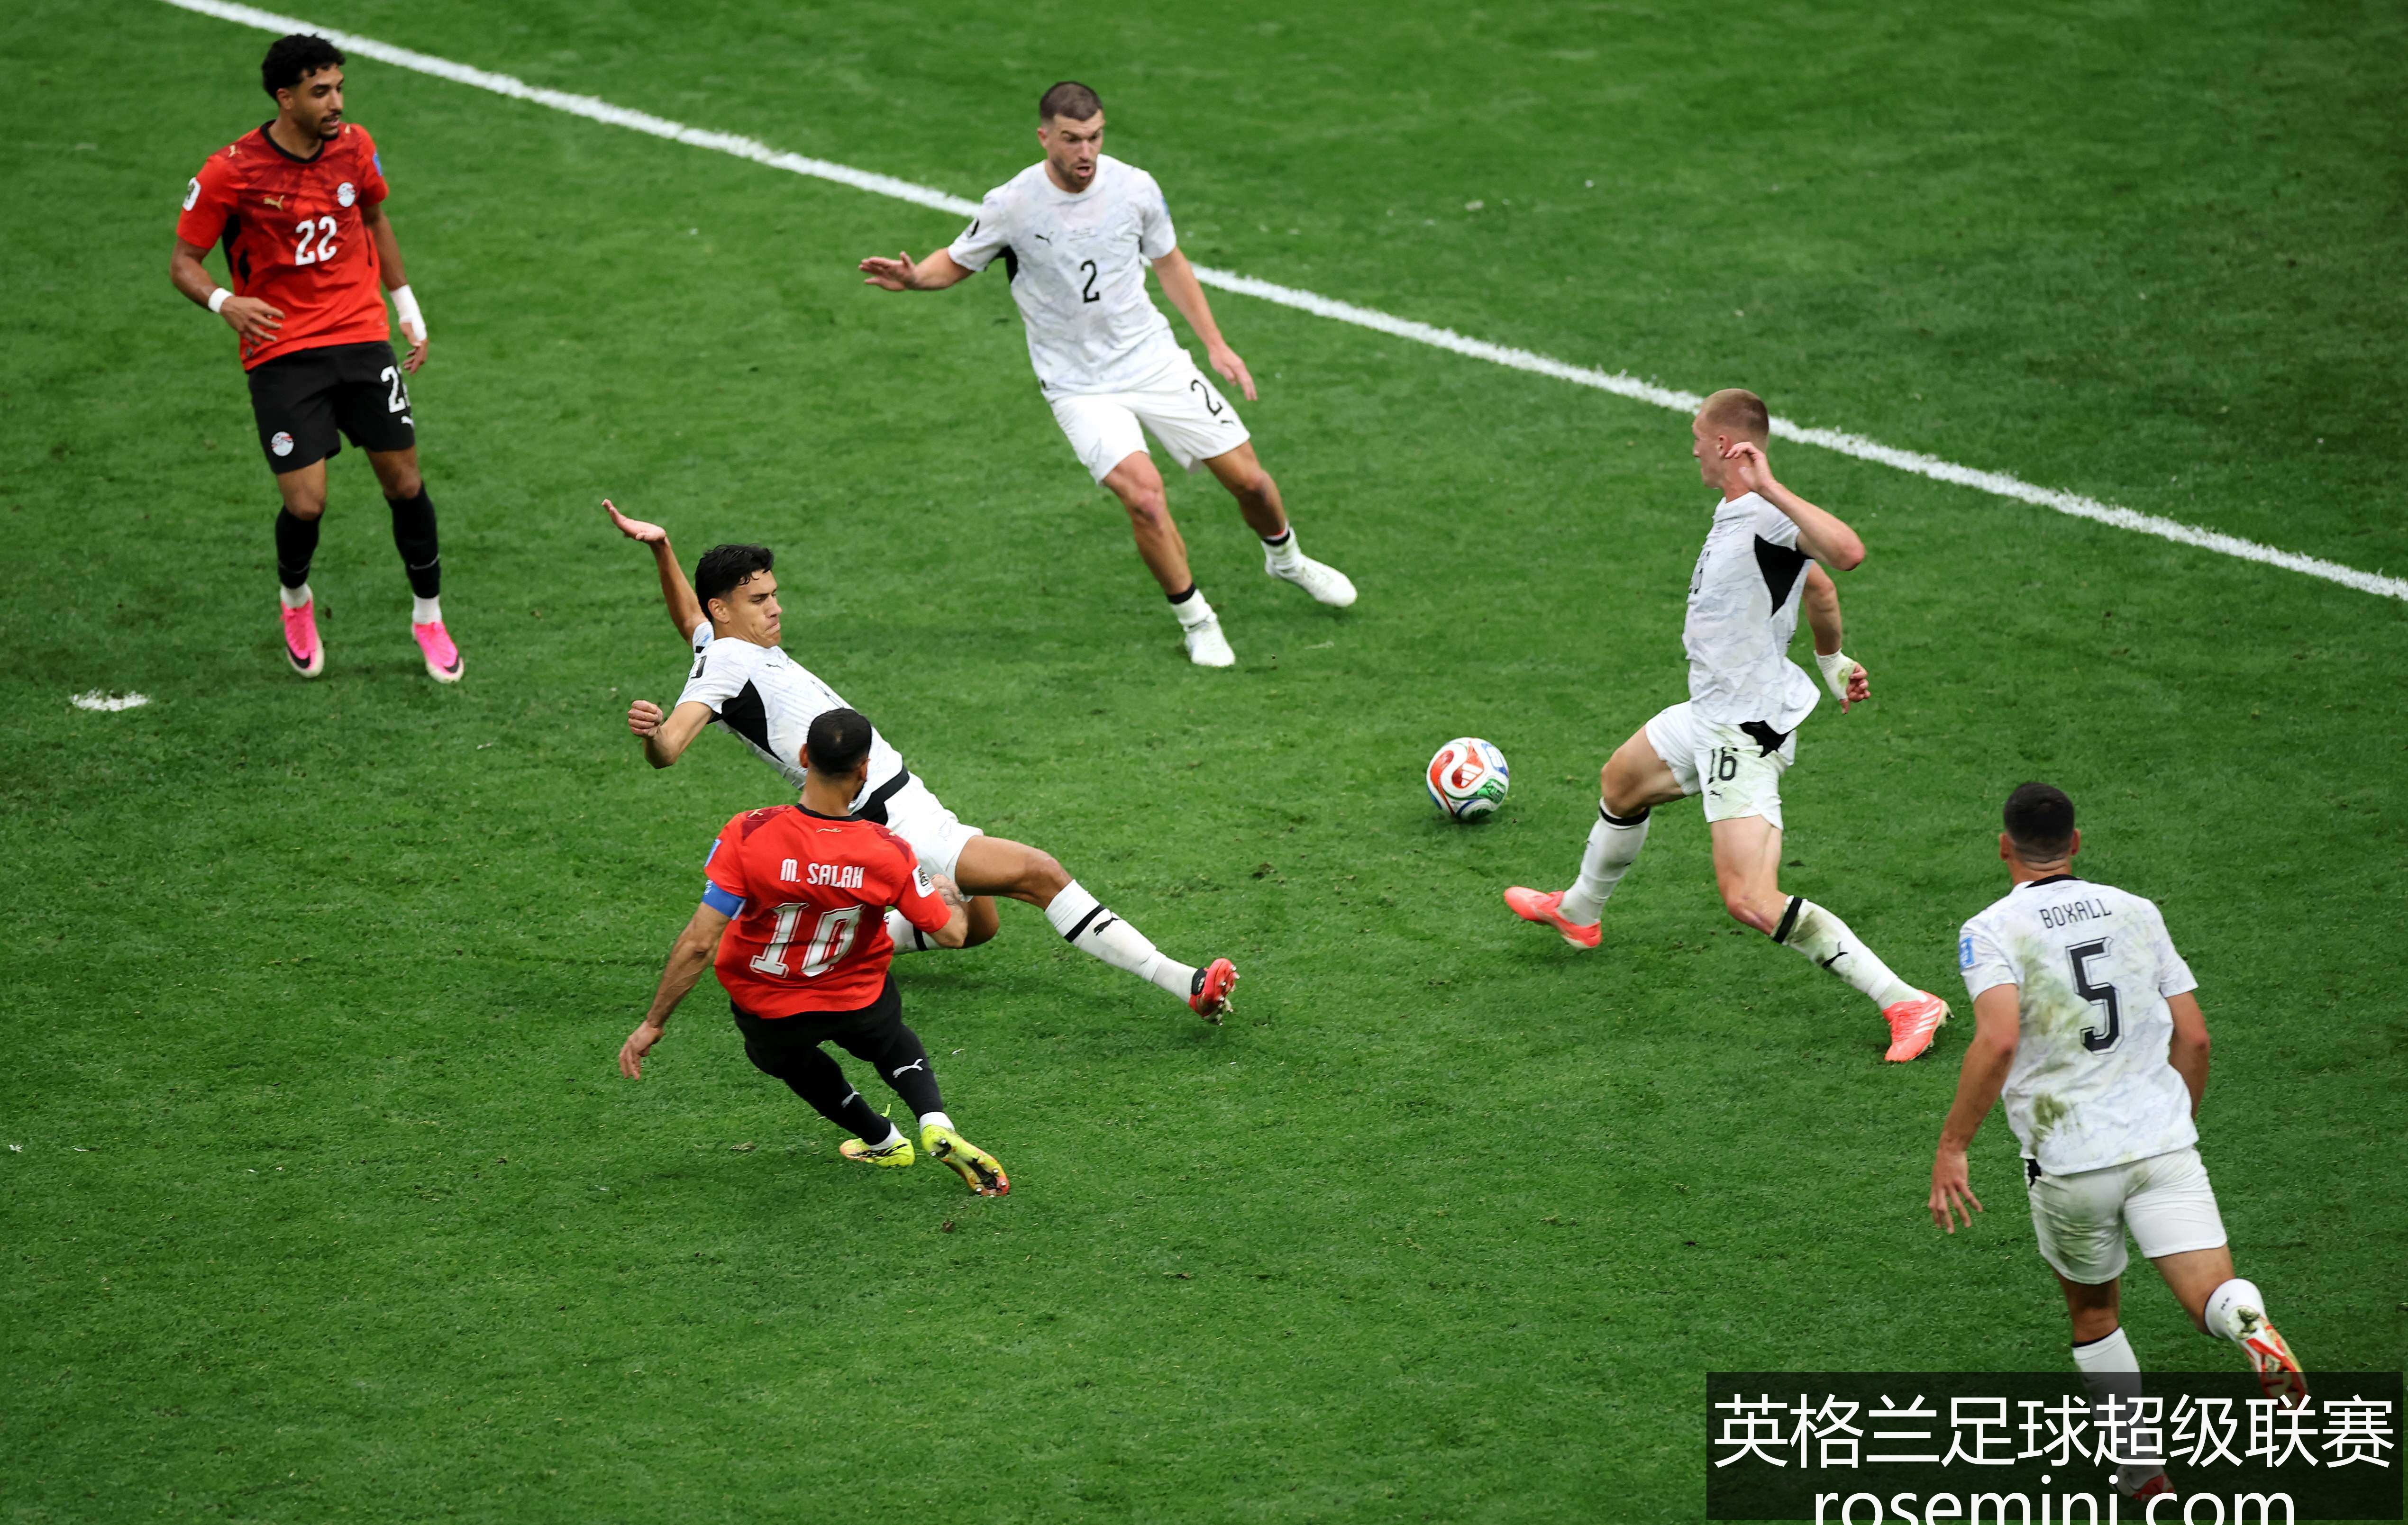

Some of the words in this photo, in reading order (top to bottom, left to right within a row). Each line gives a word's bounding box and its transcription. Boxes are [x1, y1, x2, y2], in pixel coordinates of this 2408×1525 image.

[294, 215, 337, 266] 22
[1080, 259, 1100, 304] 2
[380, 365, 410, 413] 2
[1190, 379, 1223, 416] 2
[1707, 746, 1739, 785] 16
[780, 858, 801, 883] M.
[806, 862, 865, 889] SALAH
[2039, 899, 2112, 929] BOXALL
[749, 902, 867, 979] 10
[2065, 936, 2125, 1055] 5
